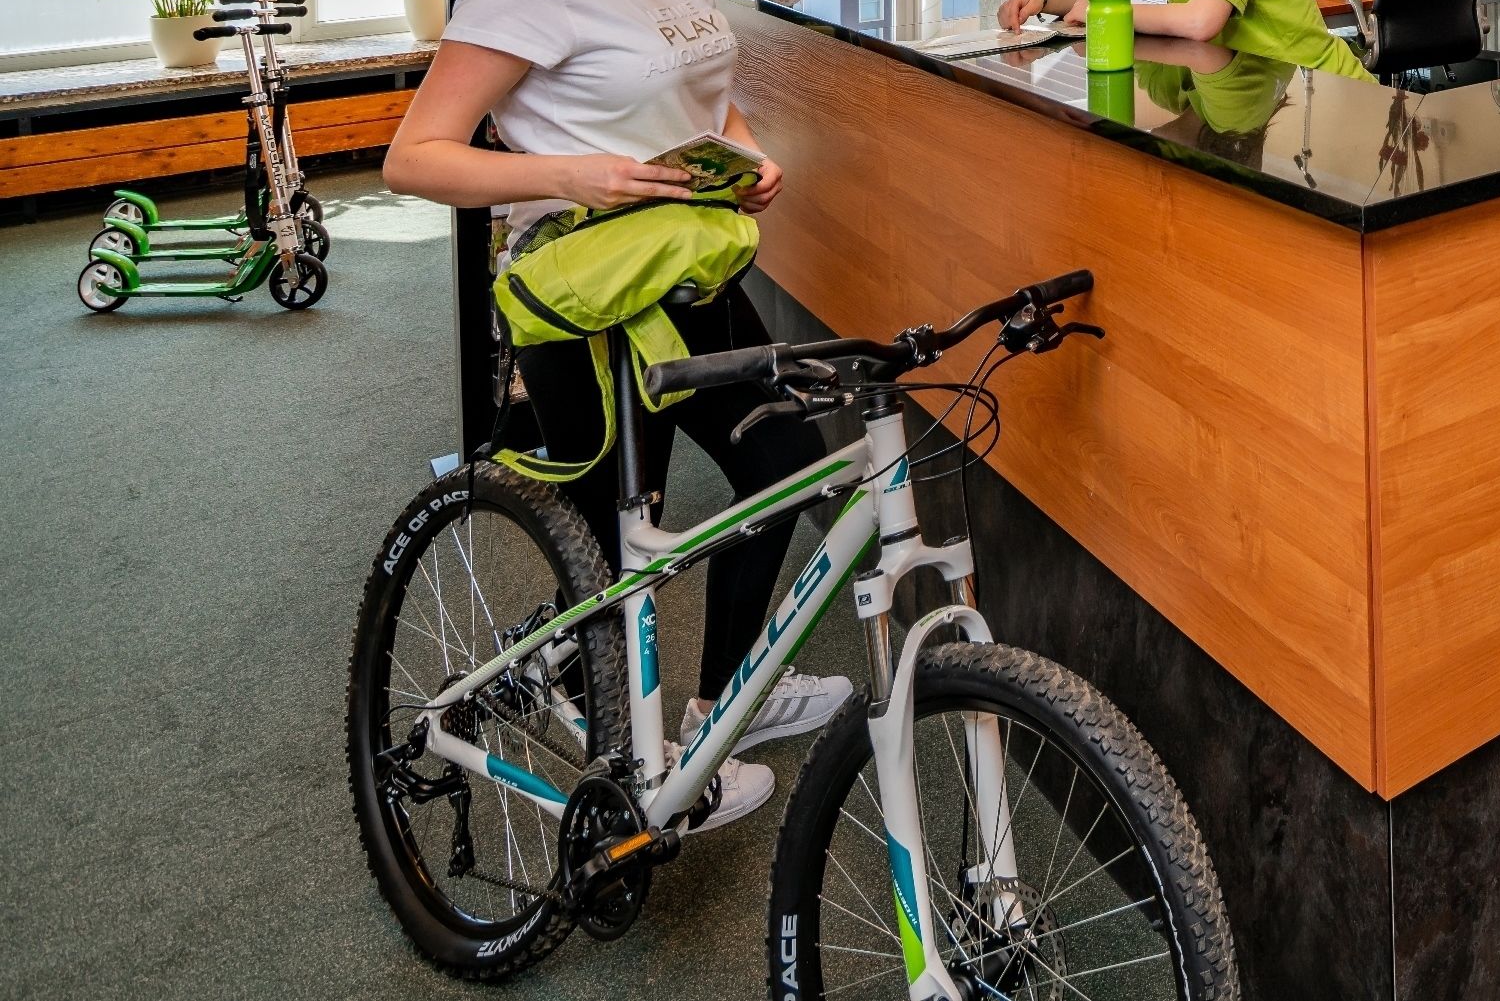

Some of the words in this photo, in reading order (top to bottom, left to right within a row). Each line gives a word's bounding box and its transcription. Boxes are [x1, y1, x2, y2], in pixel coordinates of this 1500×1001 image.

[659, 13, 720, 47] PLAY
[383, 532, 412, 576] ACE
[408, 509, 430, 532] OF
